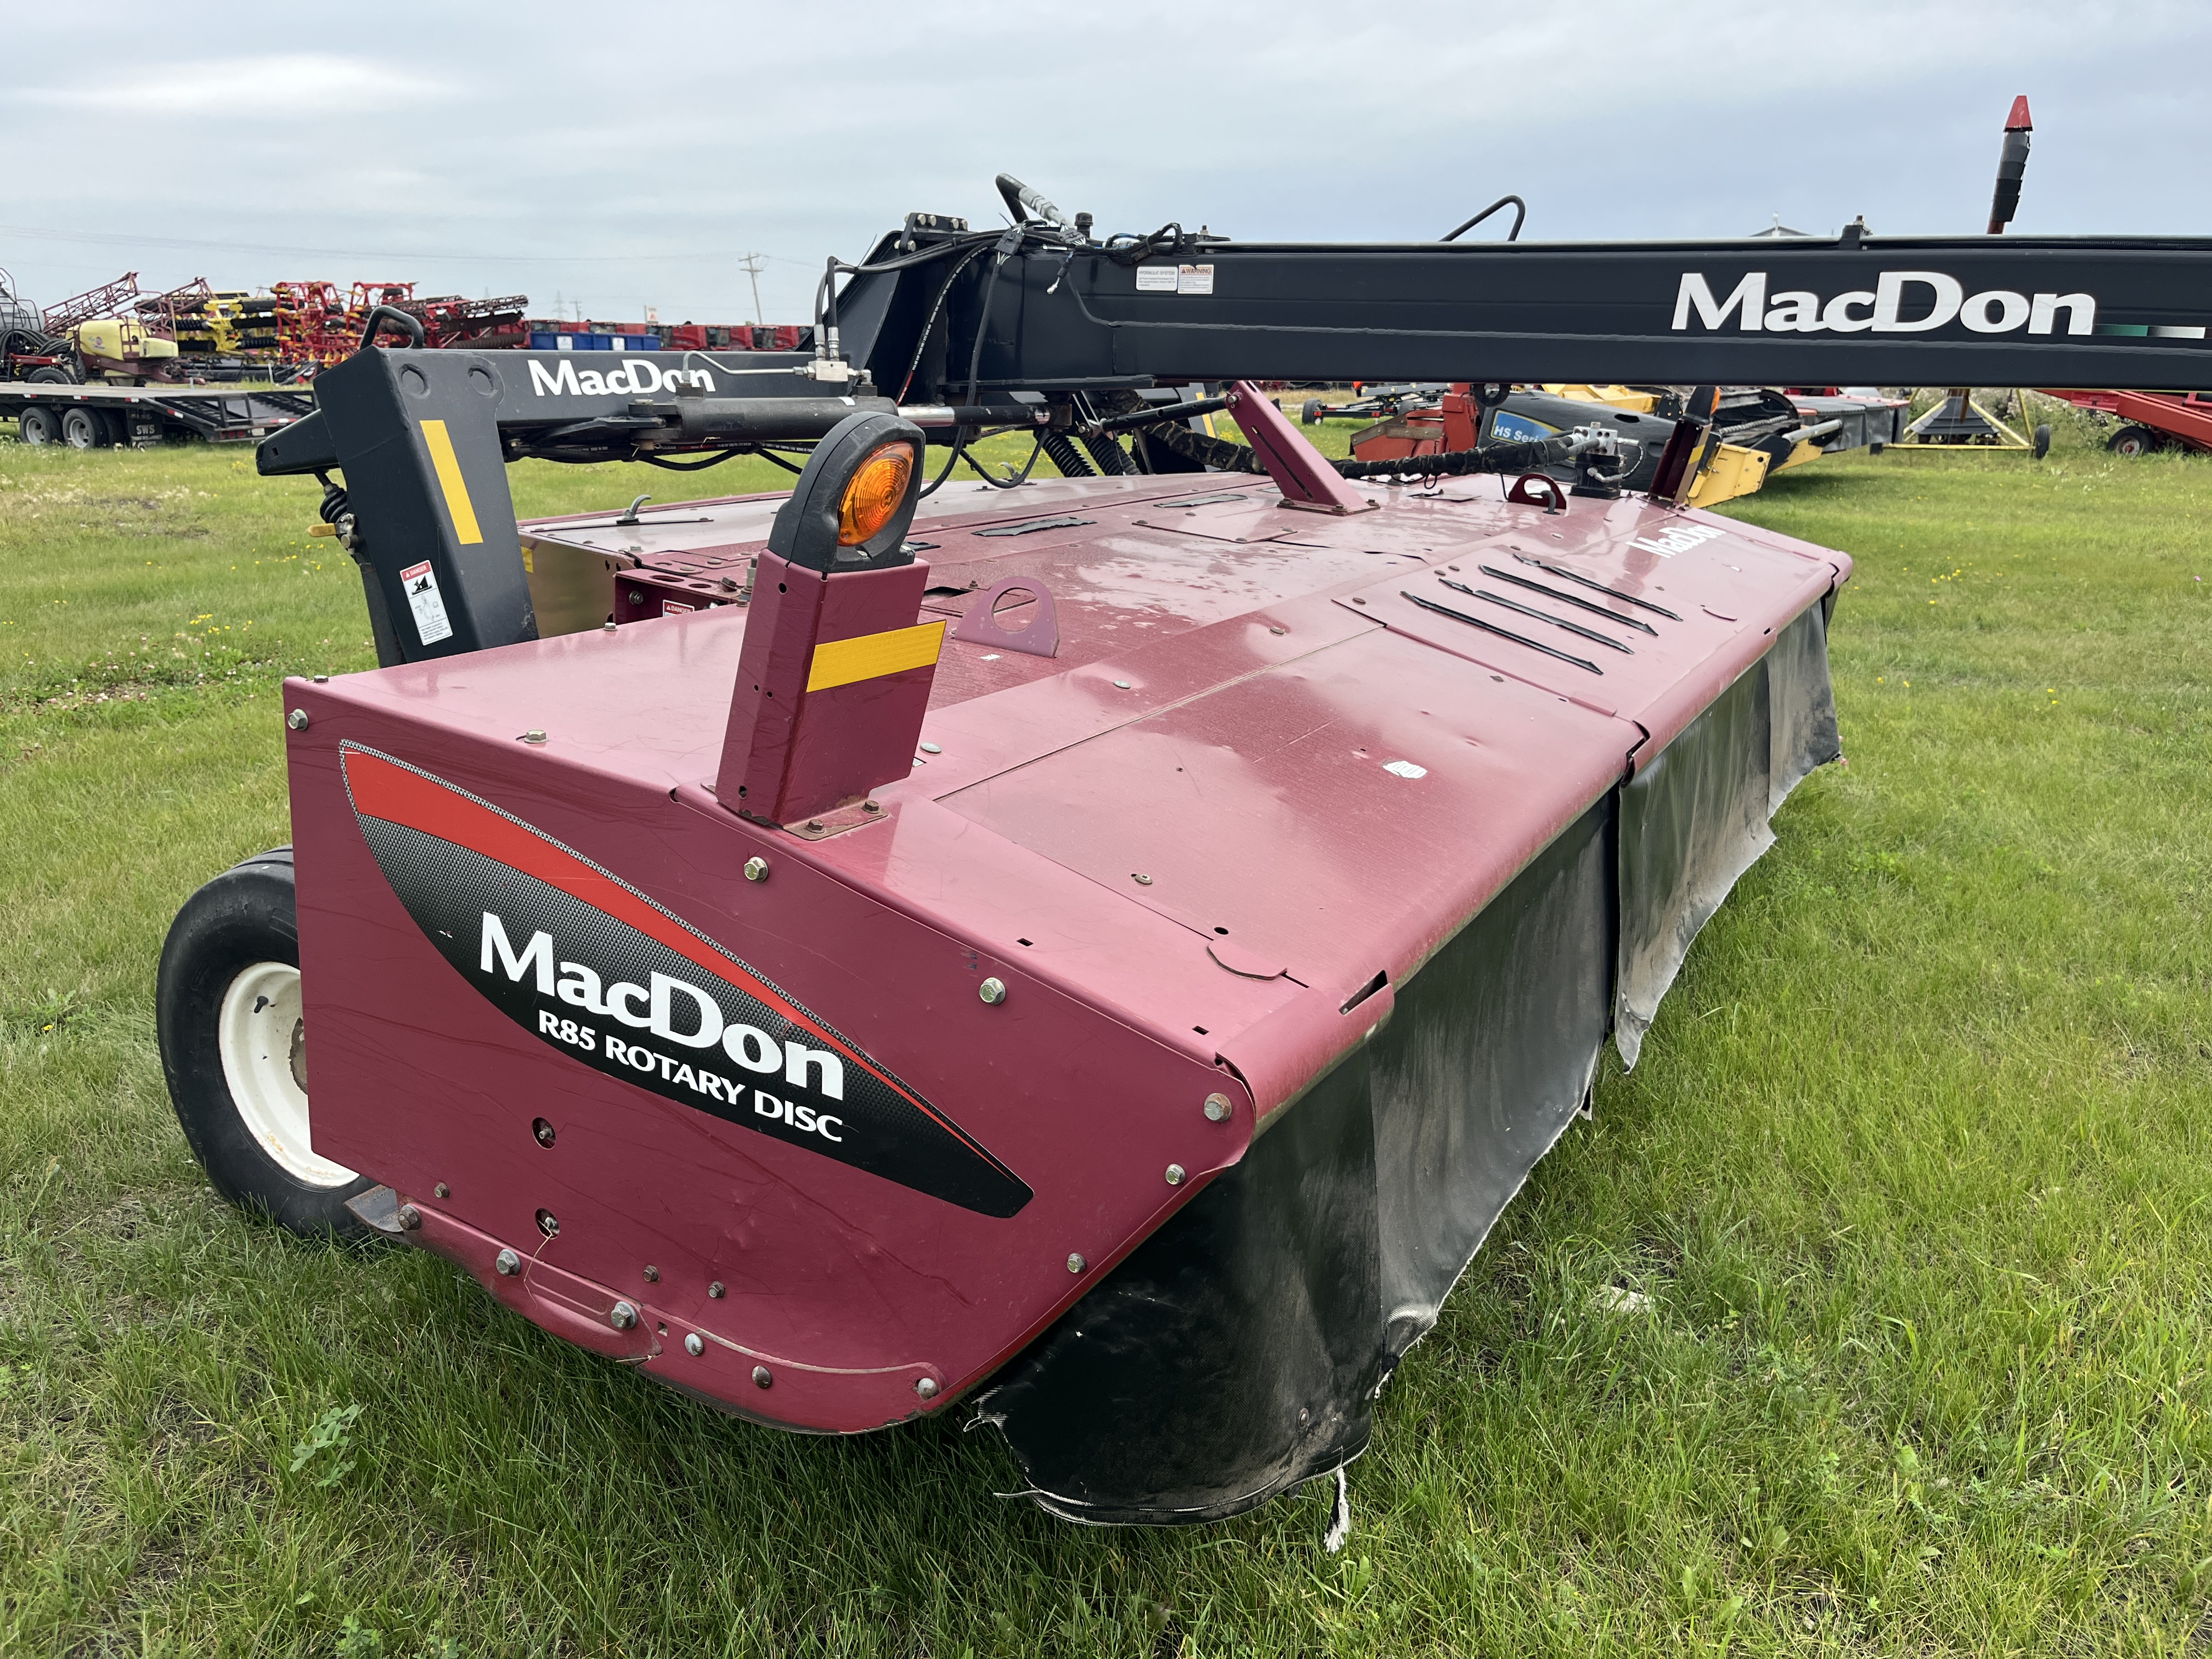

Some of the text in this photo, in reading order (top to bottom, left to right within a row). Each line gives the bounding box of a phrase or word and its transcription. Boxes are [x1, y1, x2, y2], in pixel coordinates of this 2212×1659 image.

[1671, 271, 2095, 335] MacDon
[527, 359, 716, 396] MacDon
[136, 424, 155, 435] SWS
[1493, 425, 1542, 443] HS Seri
[1625, 524, 1726, 558] MacDon
[409, 565, 427, 576] DANGER
[480, 911, 843, 1101] MacDon
[538, 1009, 843, 1143] R85 ROTARY DISC
